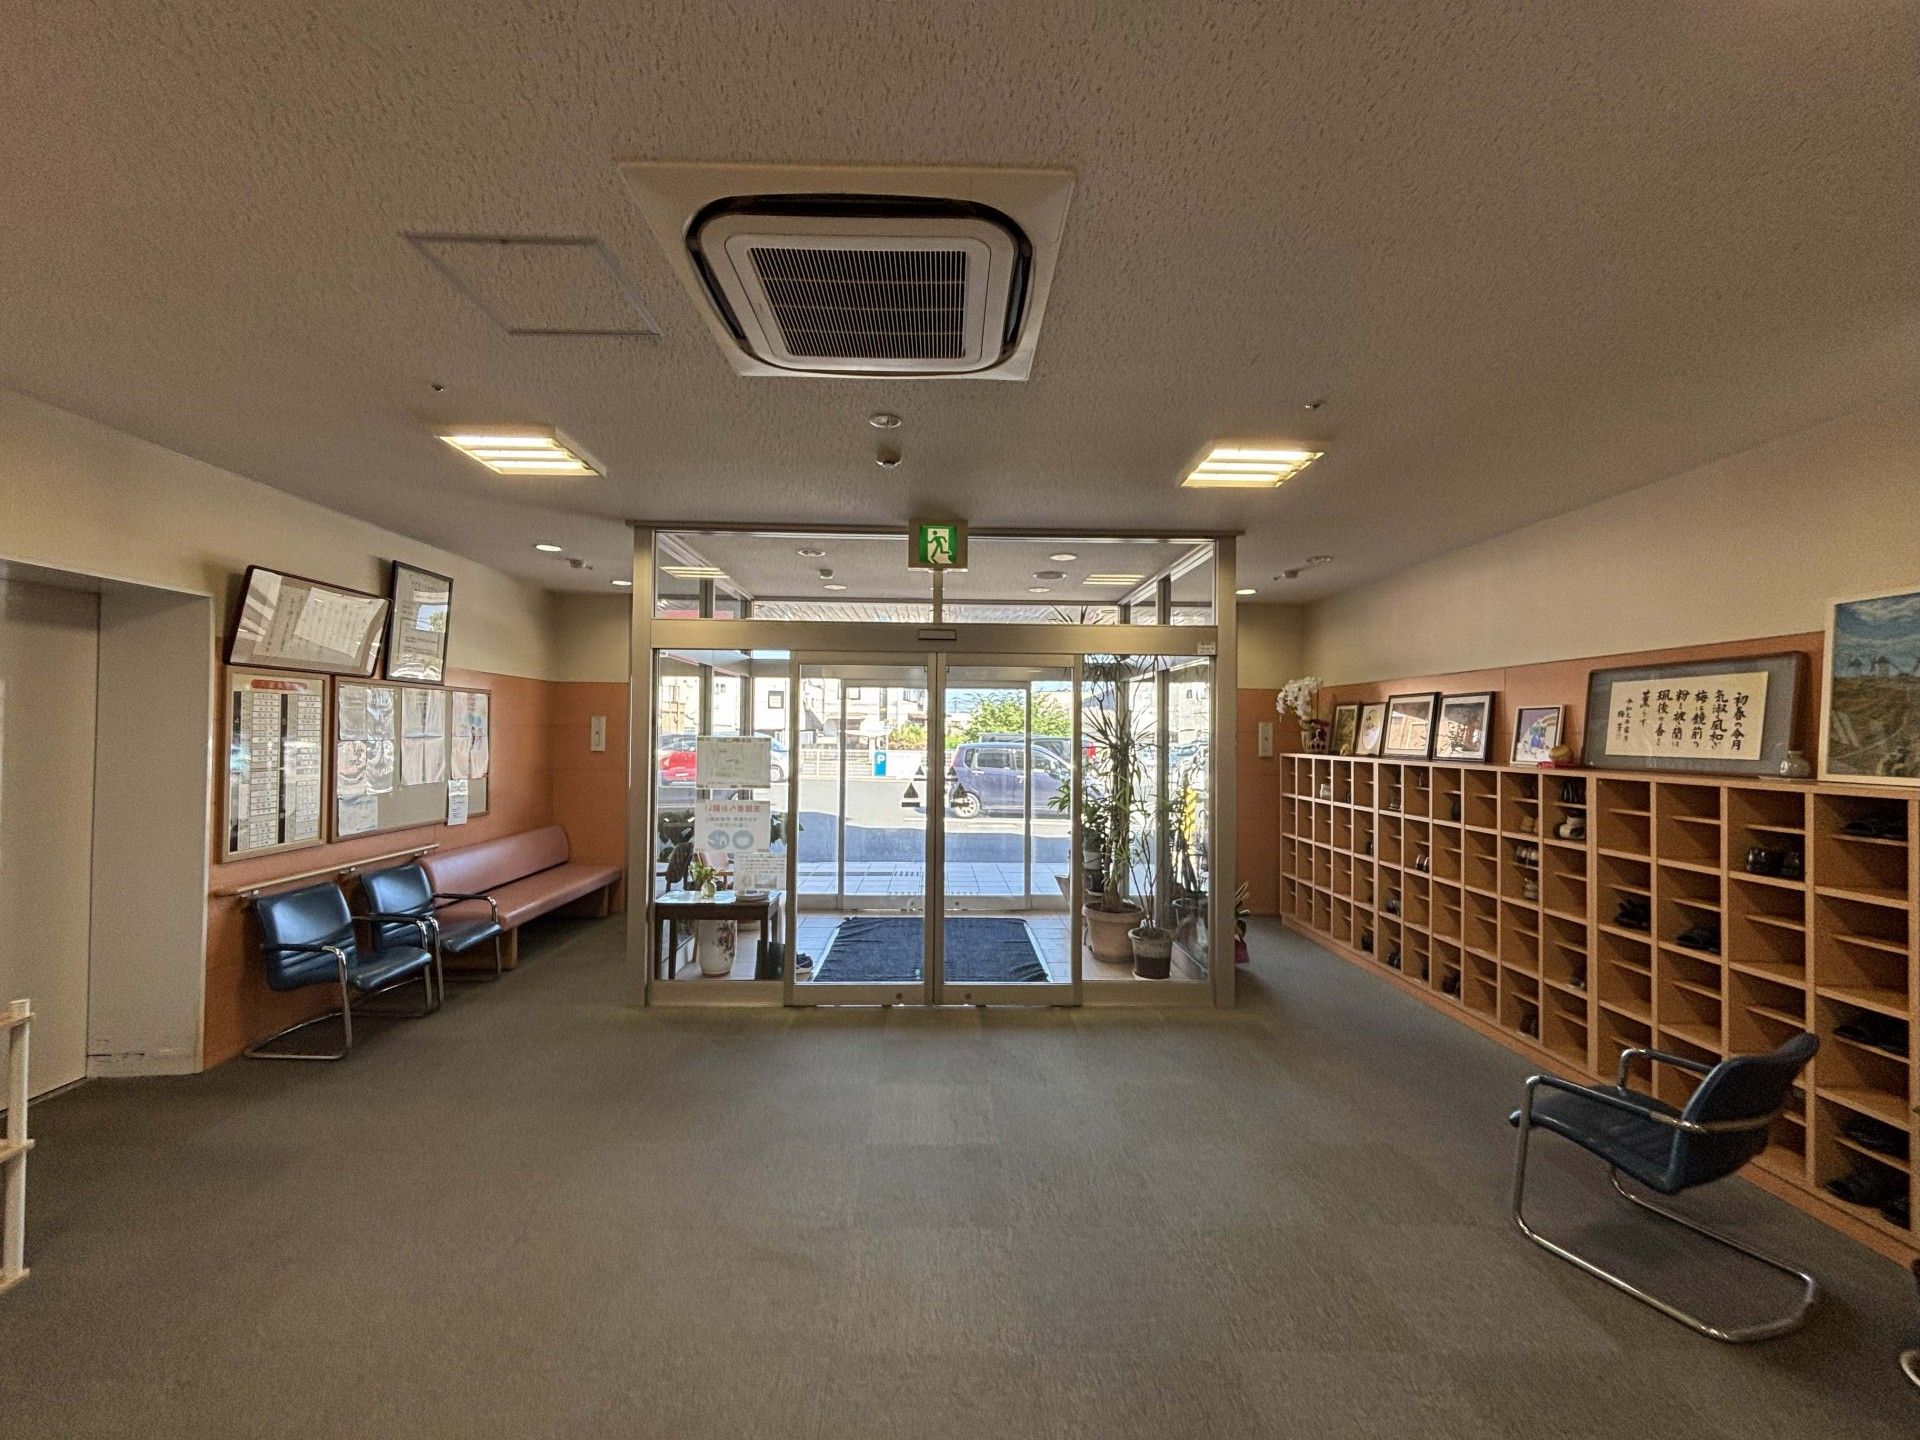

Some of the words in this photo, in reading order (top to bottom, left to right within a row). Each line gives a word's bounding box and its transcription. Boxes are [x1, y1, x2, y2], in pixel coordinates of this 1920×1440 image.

[1691, 689, 1709, 748] 梅は鏡前の
[1731, 692, 1749, 751] 初春の令月
[877, 754, 885, 763] P
